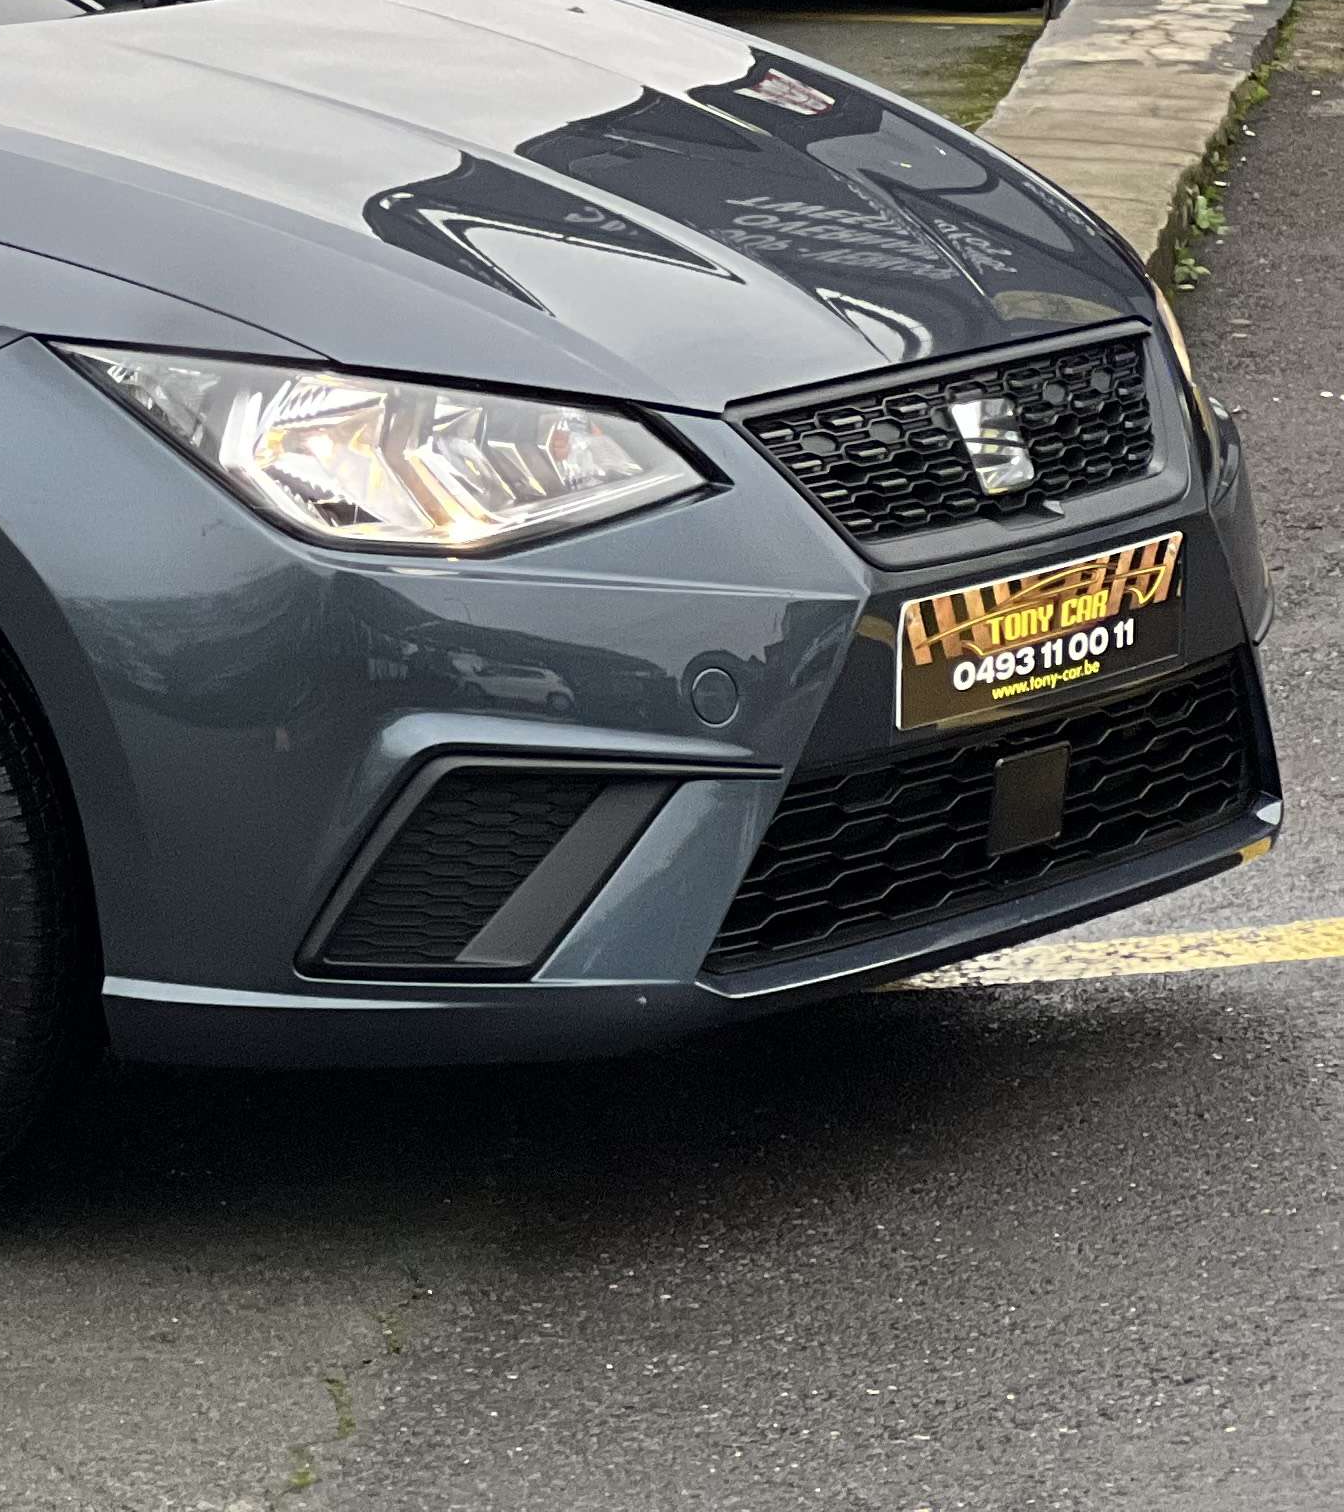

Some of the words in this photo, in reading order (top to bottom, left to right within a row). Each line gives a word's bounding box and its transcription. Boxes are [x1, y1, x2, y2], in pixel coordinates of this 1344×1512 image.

[986, 602, 1055, 646] TONY
[1060, 589, 1110, 628] CAR
[953, 647, 1035, 692] 0493
[1040, 638, 1064, 670] 11
[1069, 626, 1109, 662] 00
[1114, 618, 1135, 649] 11
[991, 660, 1101, 701] www.tony-car.be
